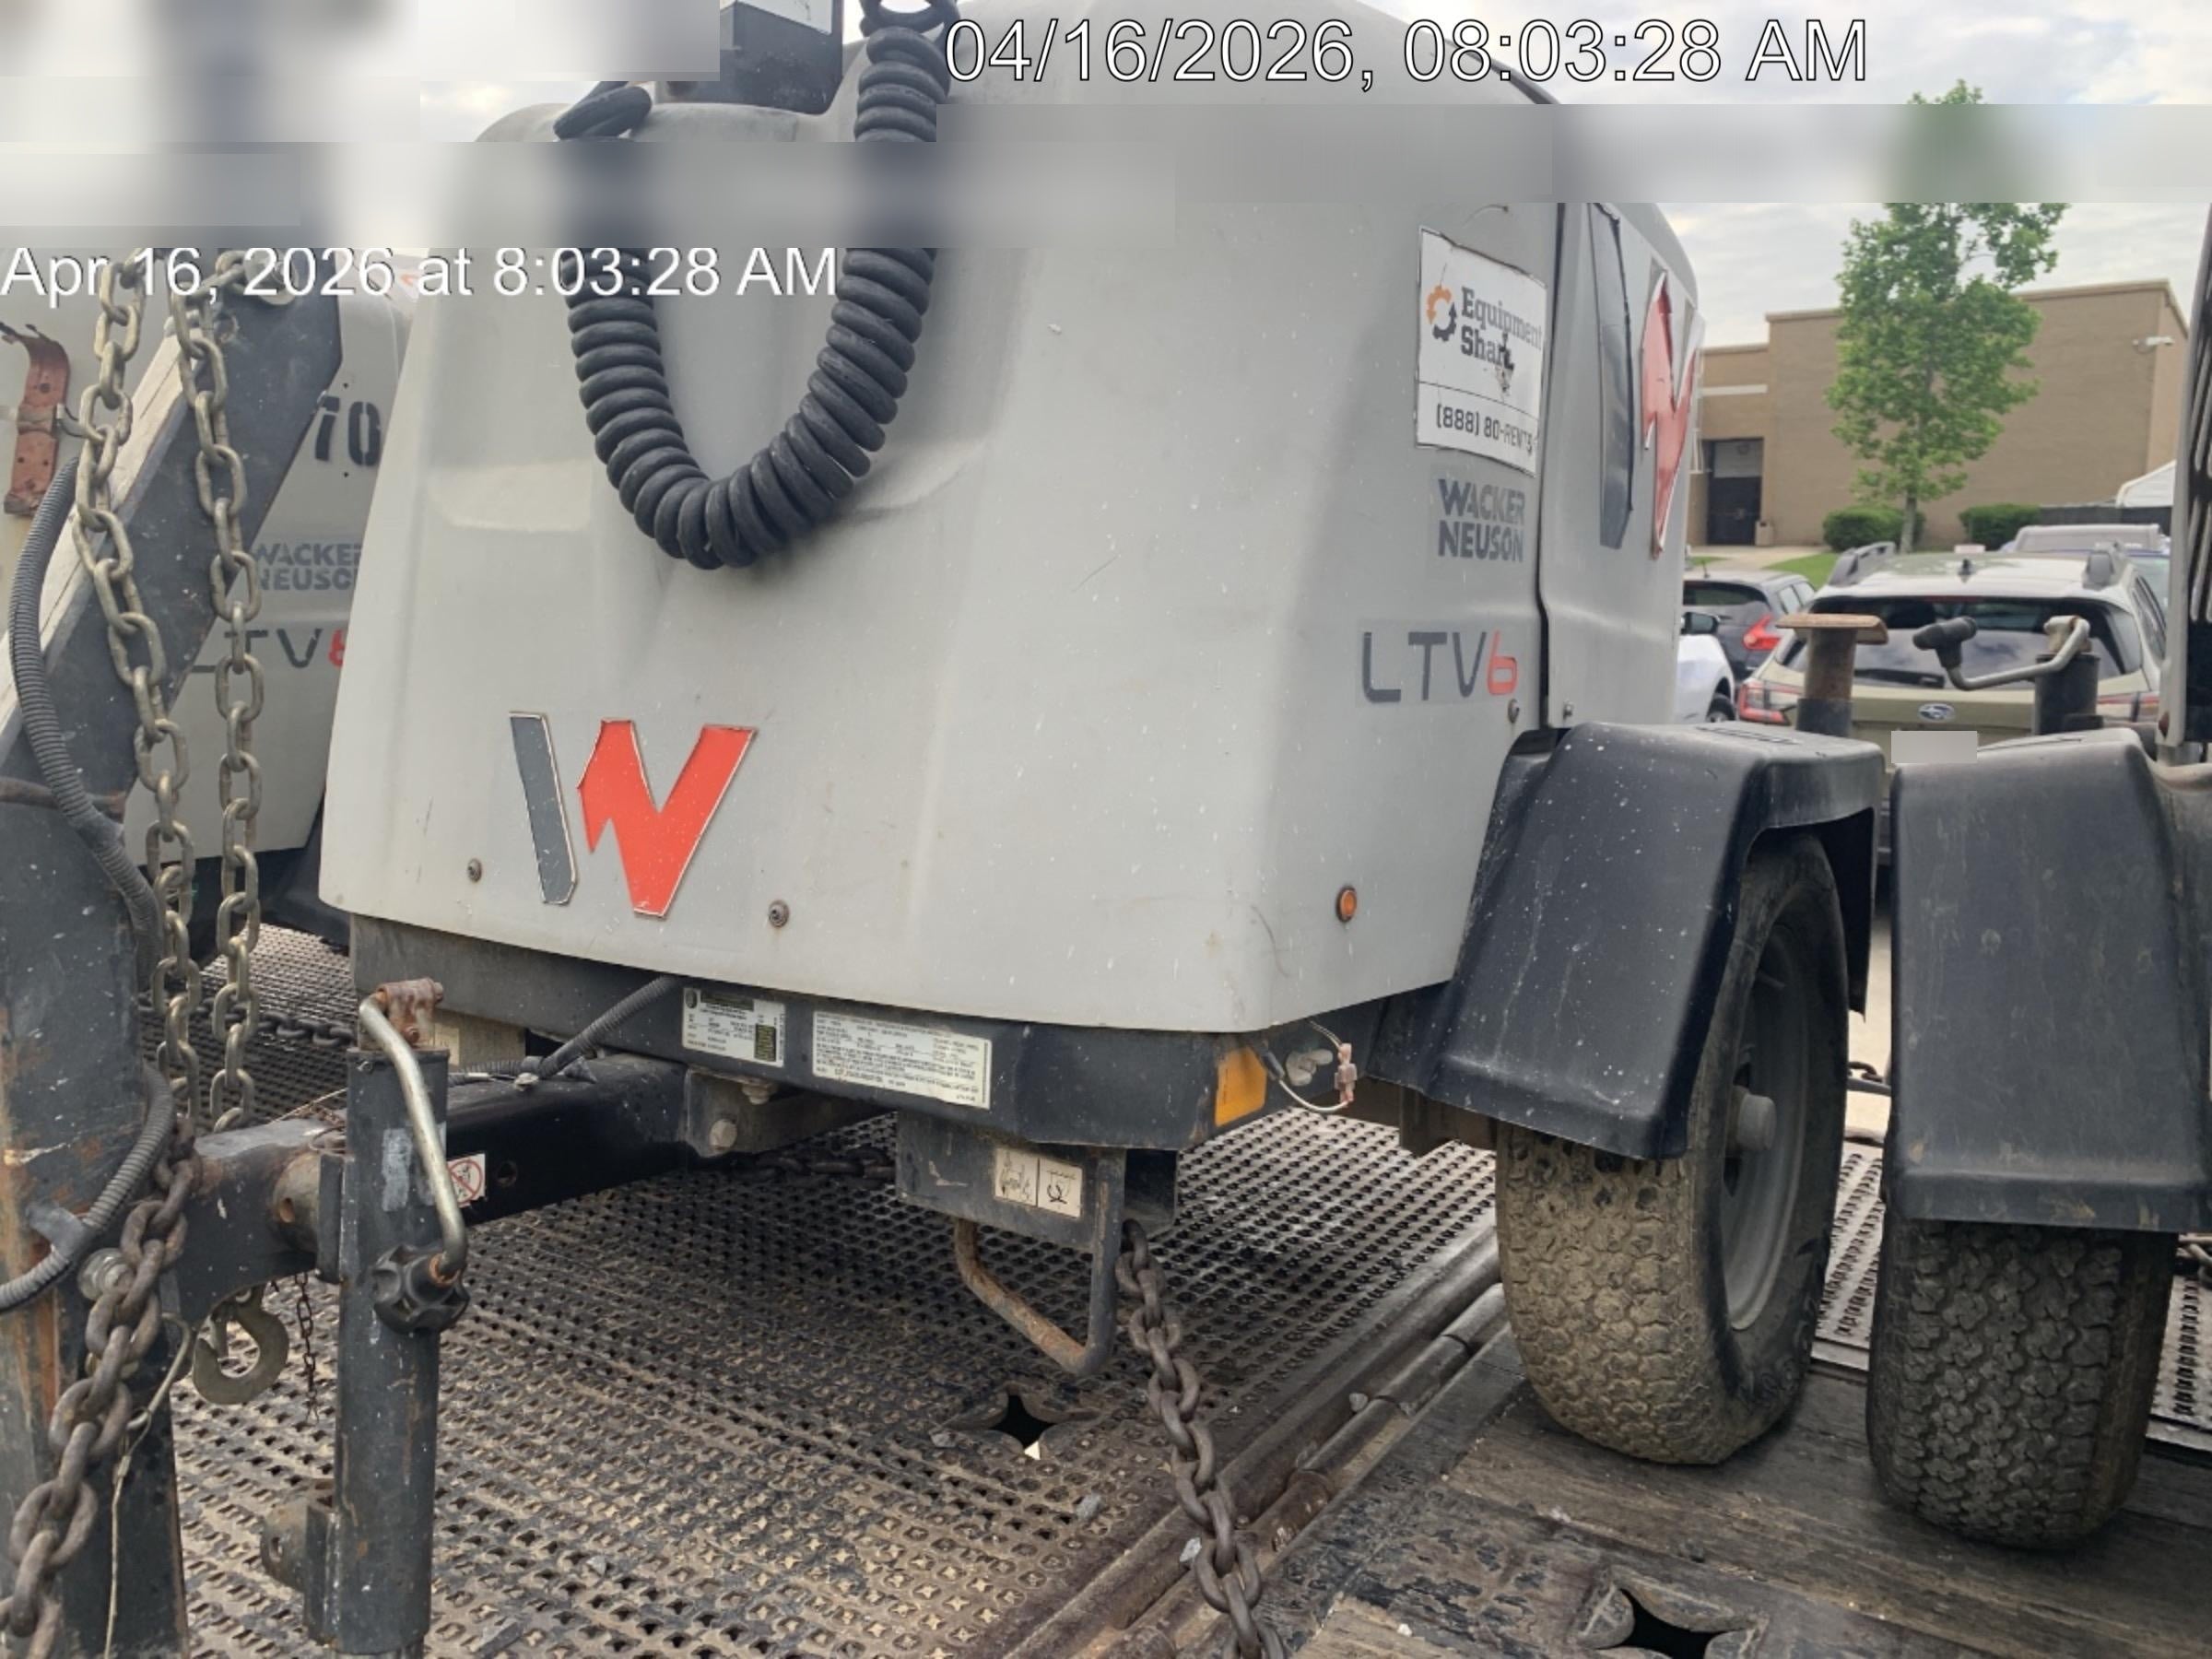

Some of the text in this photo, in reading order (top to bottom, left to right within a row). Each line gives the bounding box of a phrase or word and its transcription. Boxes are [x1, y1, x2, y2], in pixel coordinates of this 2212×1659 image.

[1461, 286, 1543, 351] Equipment
[1437, 404, 1479, 436] (888)
[1438, 478, 1526, 526] WACKER
[1438, 520, 1525, 563] NEUSON
[260, 567, 358, 591] EUSO
[1362, 629, 1519, 704] LTV6
